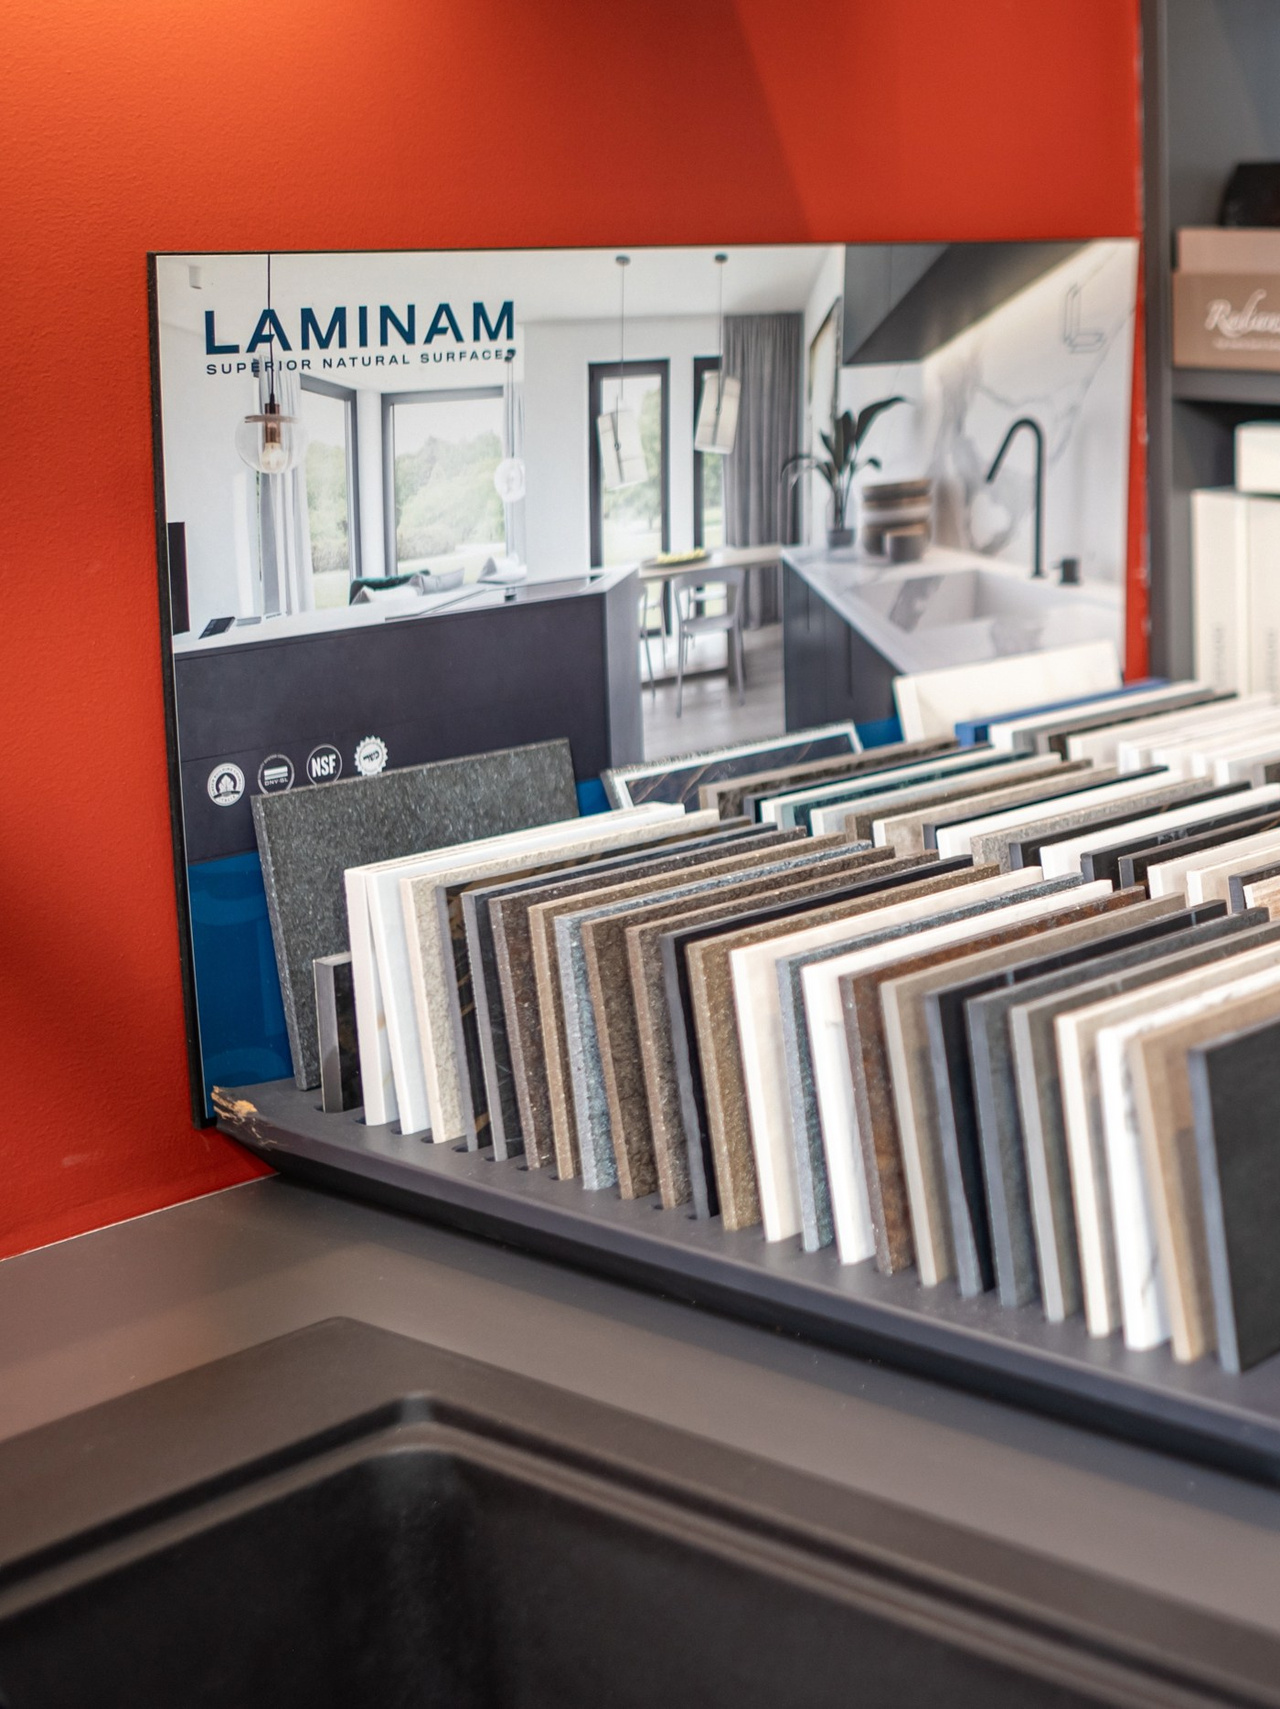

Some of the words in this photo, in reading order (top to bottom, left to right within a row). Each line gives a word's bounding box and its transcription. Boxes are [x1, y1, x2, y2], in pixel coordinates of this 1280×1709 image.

[204, 300, 514, 356] LAMINAM
[206, 359, 312, 375] SUPERIOR
[322, 354, 411, 369] NATURAL
[311, 753, 336, 778] NSF
